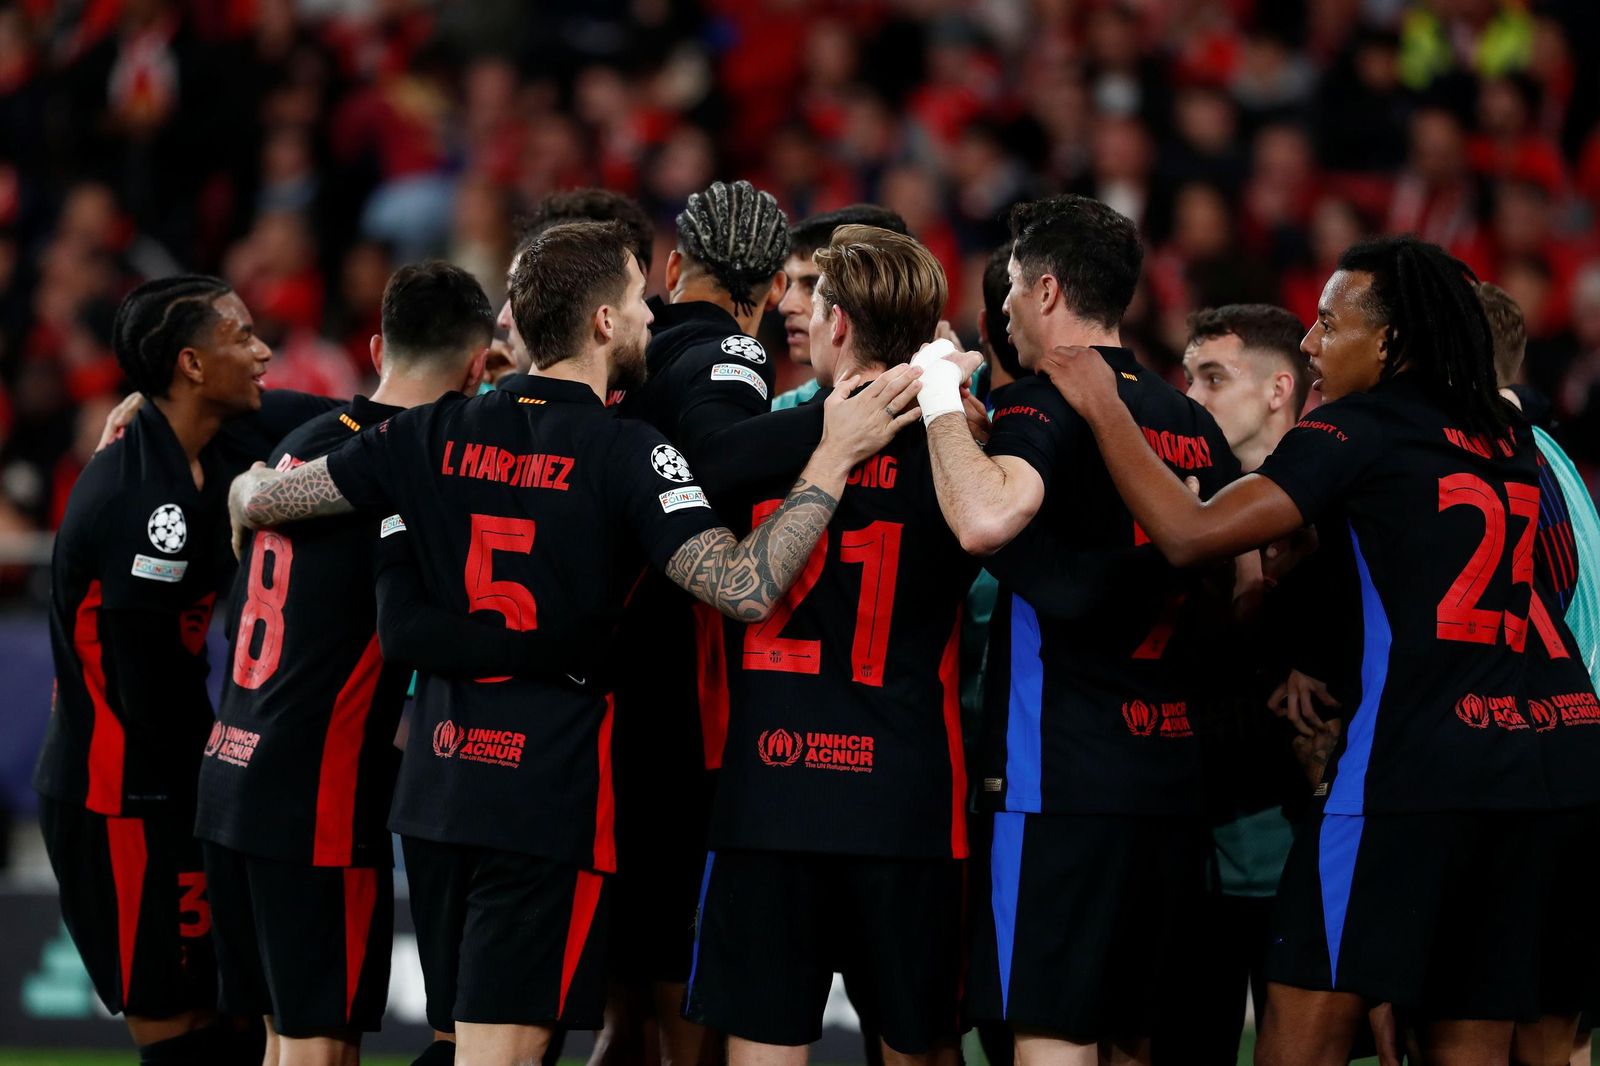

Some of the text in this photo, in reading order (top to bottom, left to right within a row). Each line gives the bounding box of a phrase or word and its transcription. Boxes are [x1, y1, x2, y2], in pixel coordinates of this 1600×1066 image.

[459, 443, 576, 491] MARTINEZ
[464, 513, 538, 683] 5
[742, 499, 904, 687] 21
[233, 530, 293, 690] 8
[1551, 692, 1598, 708] UNHCR
[226, 726, 261, 748] UNHCR
[467, 728, 526, 748] UNHCR
[806, 732, 875, 750] UNHCR
[219, 740, 254, 761] ACNUR
[460, 742, 522, 762] ACNUR
[804, 748, 873, 766] ACNUR
[178, 872, 212, 938] 3
